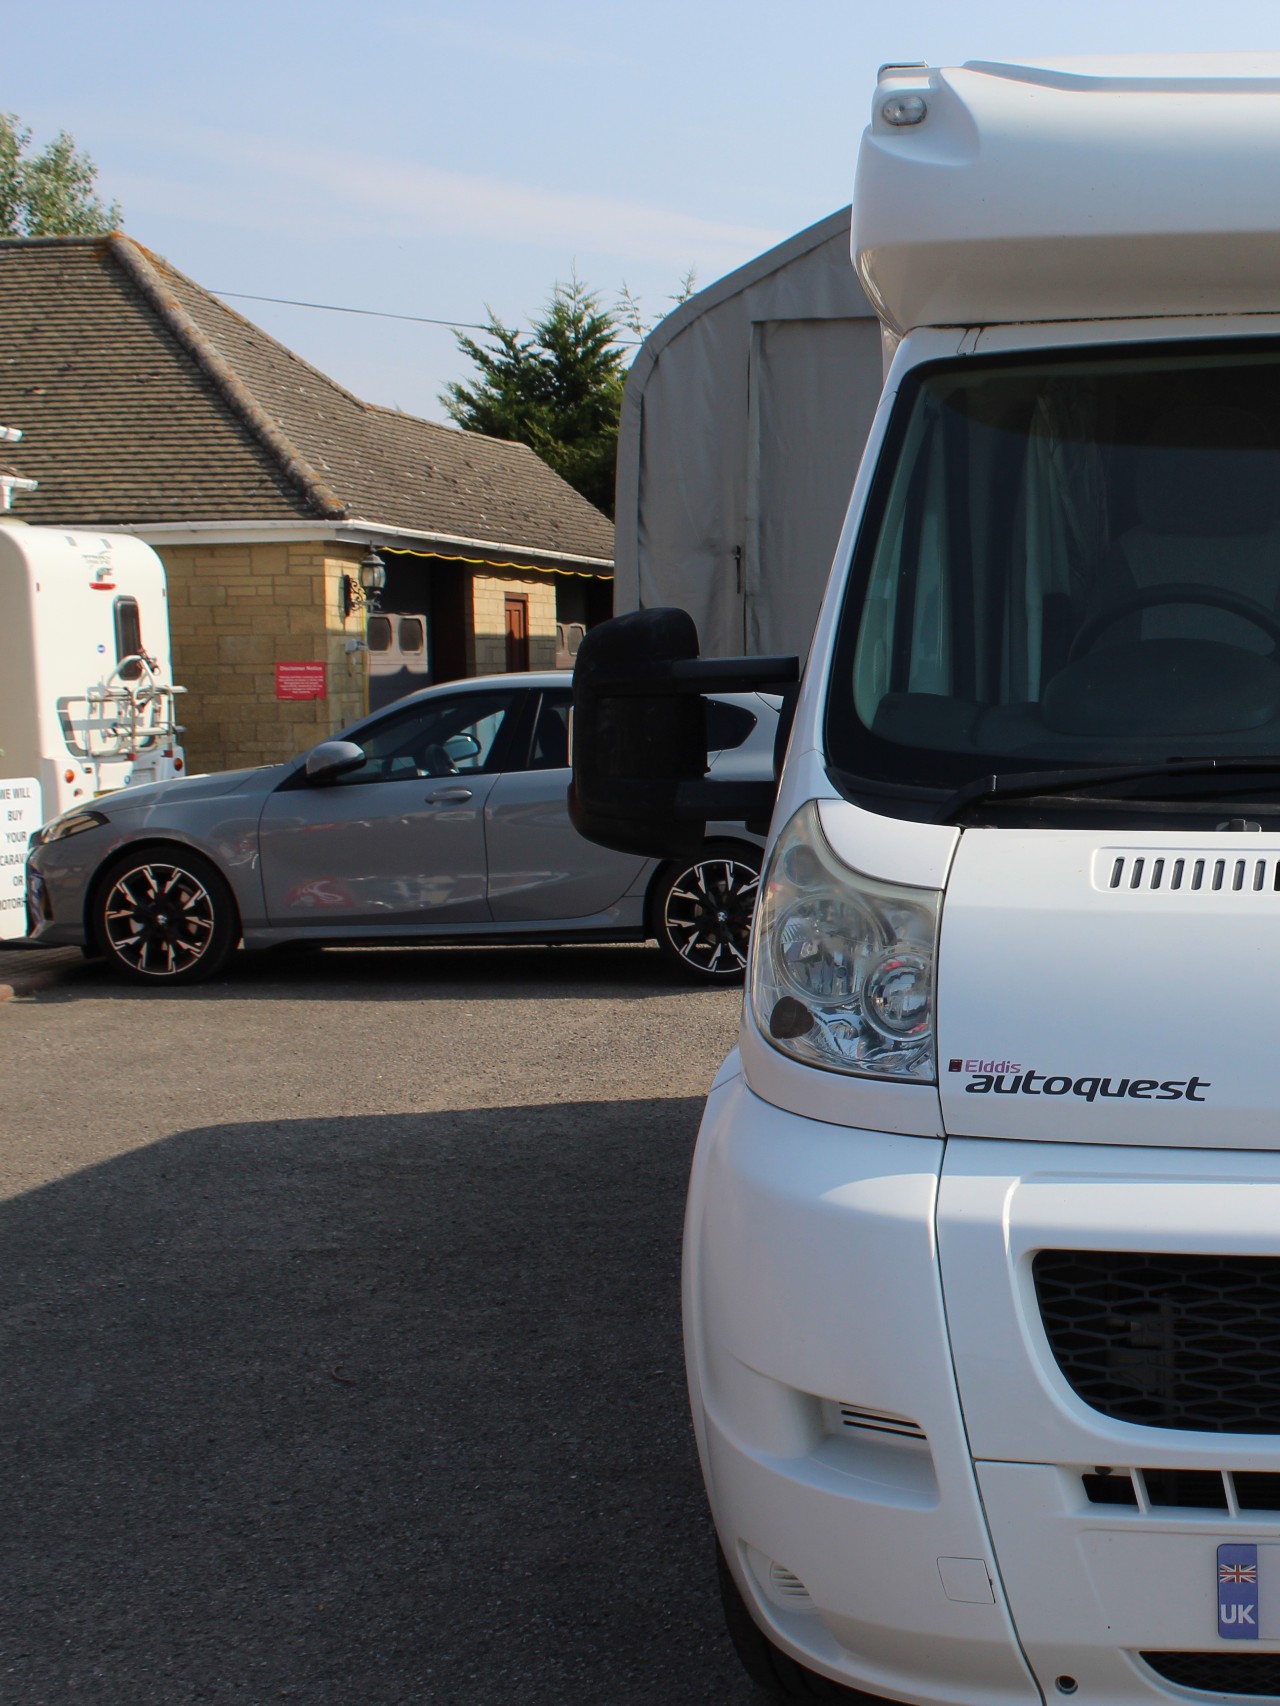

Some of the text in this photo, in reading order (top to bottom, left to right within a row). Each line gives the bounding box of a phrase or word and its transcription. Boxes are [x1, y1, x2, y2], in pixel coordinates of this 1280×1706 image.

[13, 787, 31, 799] WILL
[8, 809, 23, 822] BUY
[6, 831, 27, 844] YOUR
[0, 853, 27, 867] CARAV
[13, 874, 24, 887] OR
[965, 1059, 1022, 1074] Elddis
[965, 1070, 1212, 1103] autoquest
[1220, 1603, 1256, 1625] UK
